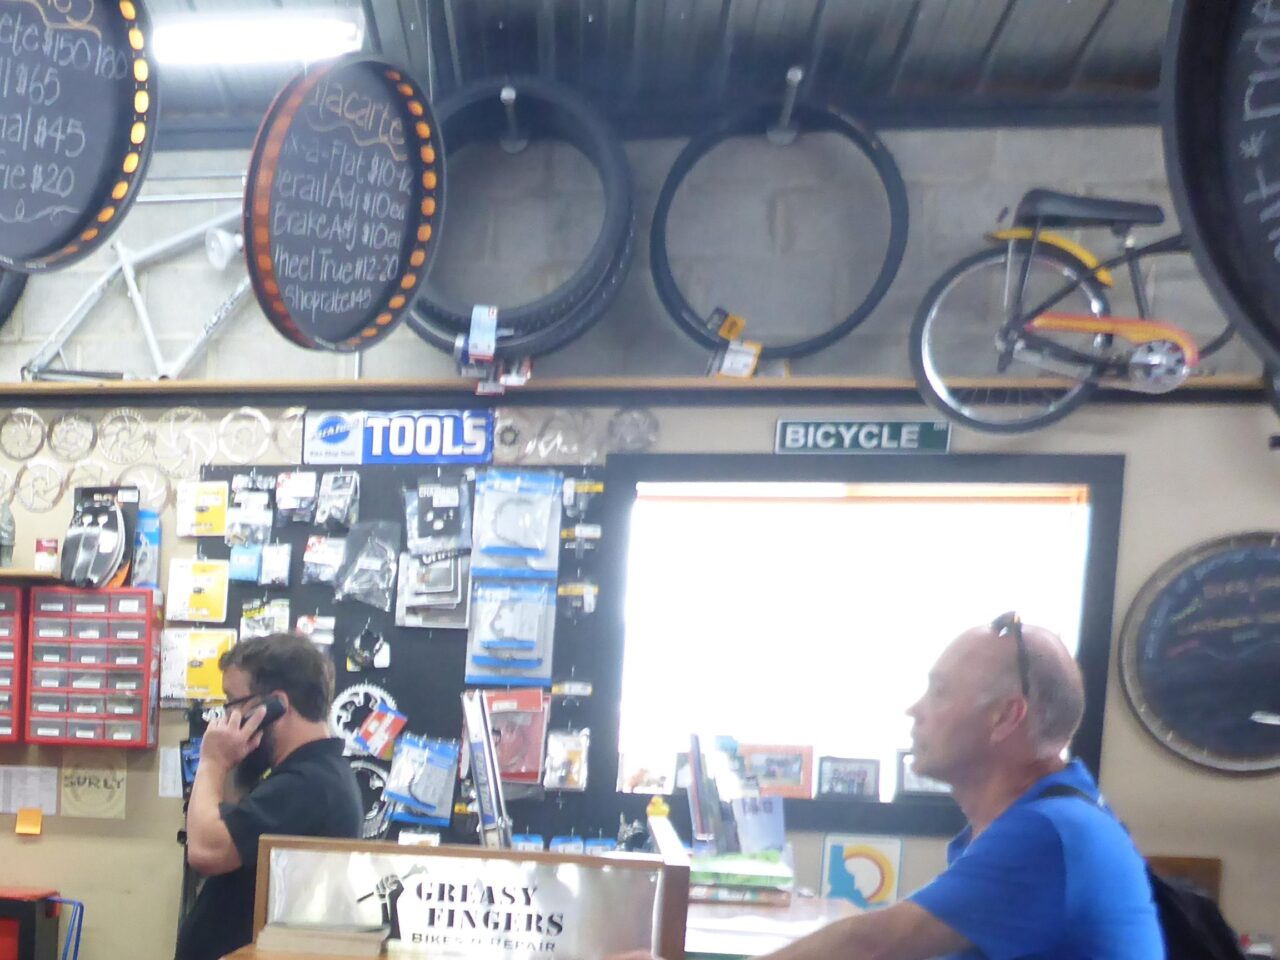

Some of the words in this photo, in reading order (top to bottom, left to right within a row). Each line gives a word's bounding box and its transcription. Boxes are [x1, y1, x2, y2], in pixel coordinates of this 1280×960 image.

[16, 63, 61, 106] $65
[33, 113, 86, 158] $45
[31, 162, 75, 198] $20
[365, 415, 488, 457] TOOLS
[785, 423, 920, 449] BICYCLE
[64, 774, 125, 790] SURLY
[416, 881, 539, 908] GREASY
[428, 907, 564, 937] FINGERS
